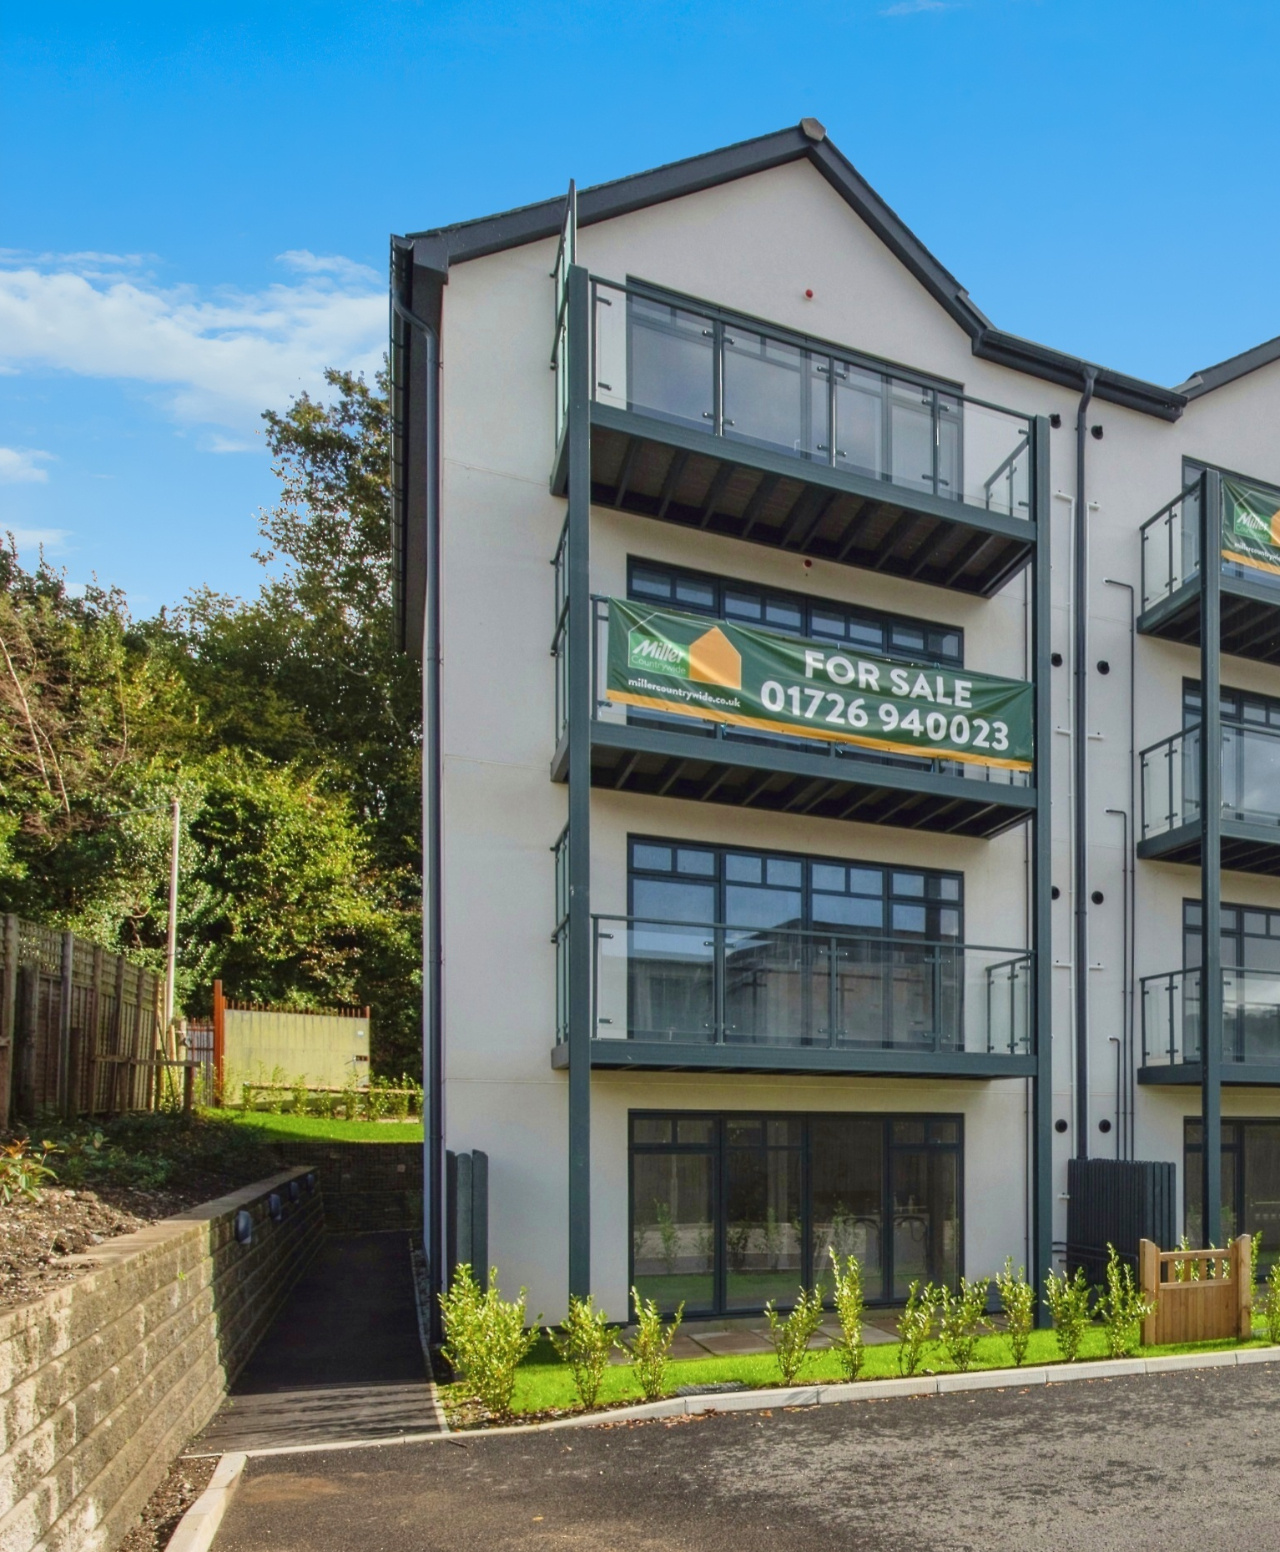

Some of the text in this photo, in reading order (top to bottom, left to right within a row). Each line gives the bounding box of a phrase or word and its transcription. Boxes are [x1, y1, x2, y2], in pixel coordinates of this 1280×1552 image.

[631, 654, 687, 675] Countrywide
[632, 639, 684, 663] Miller
[628, 678, 741, 708] millercountrywide.co.uk
[804, 650, 973, 709] FOR SALE
[760, 680, 1010, 752] 01726 940023
